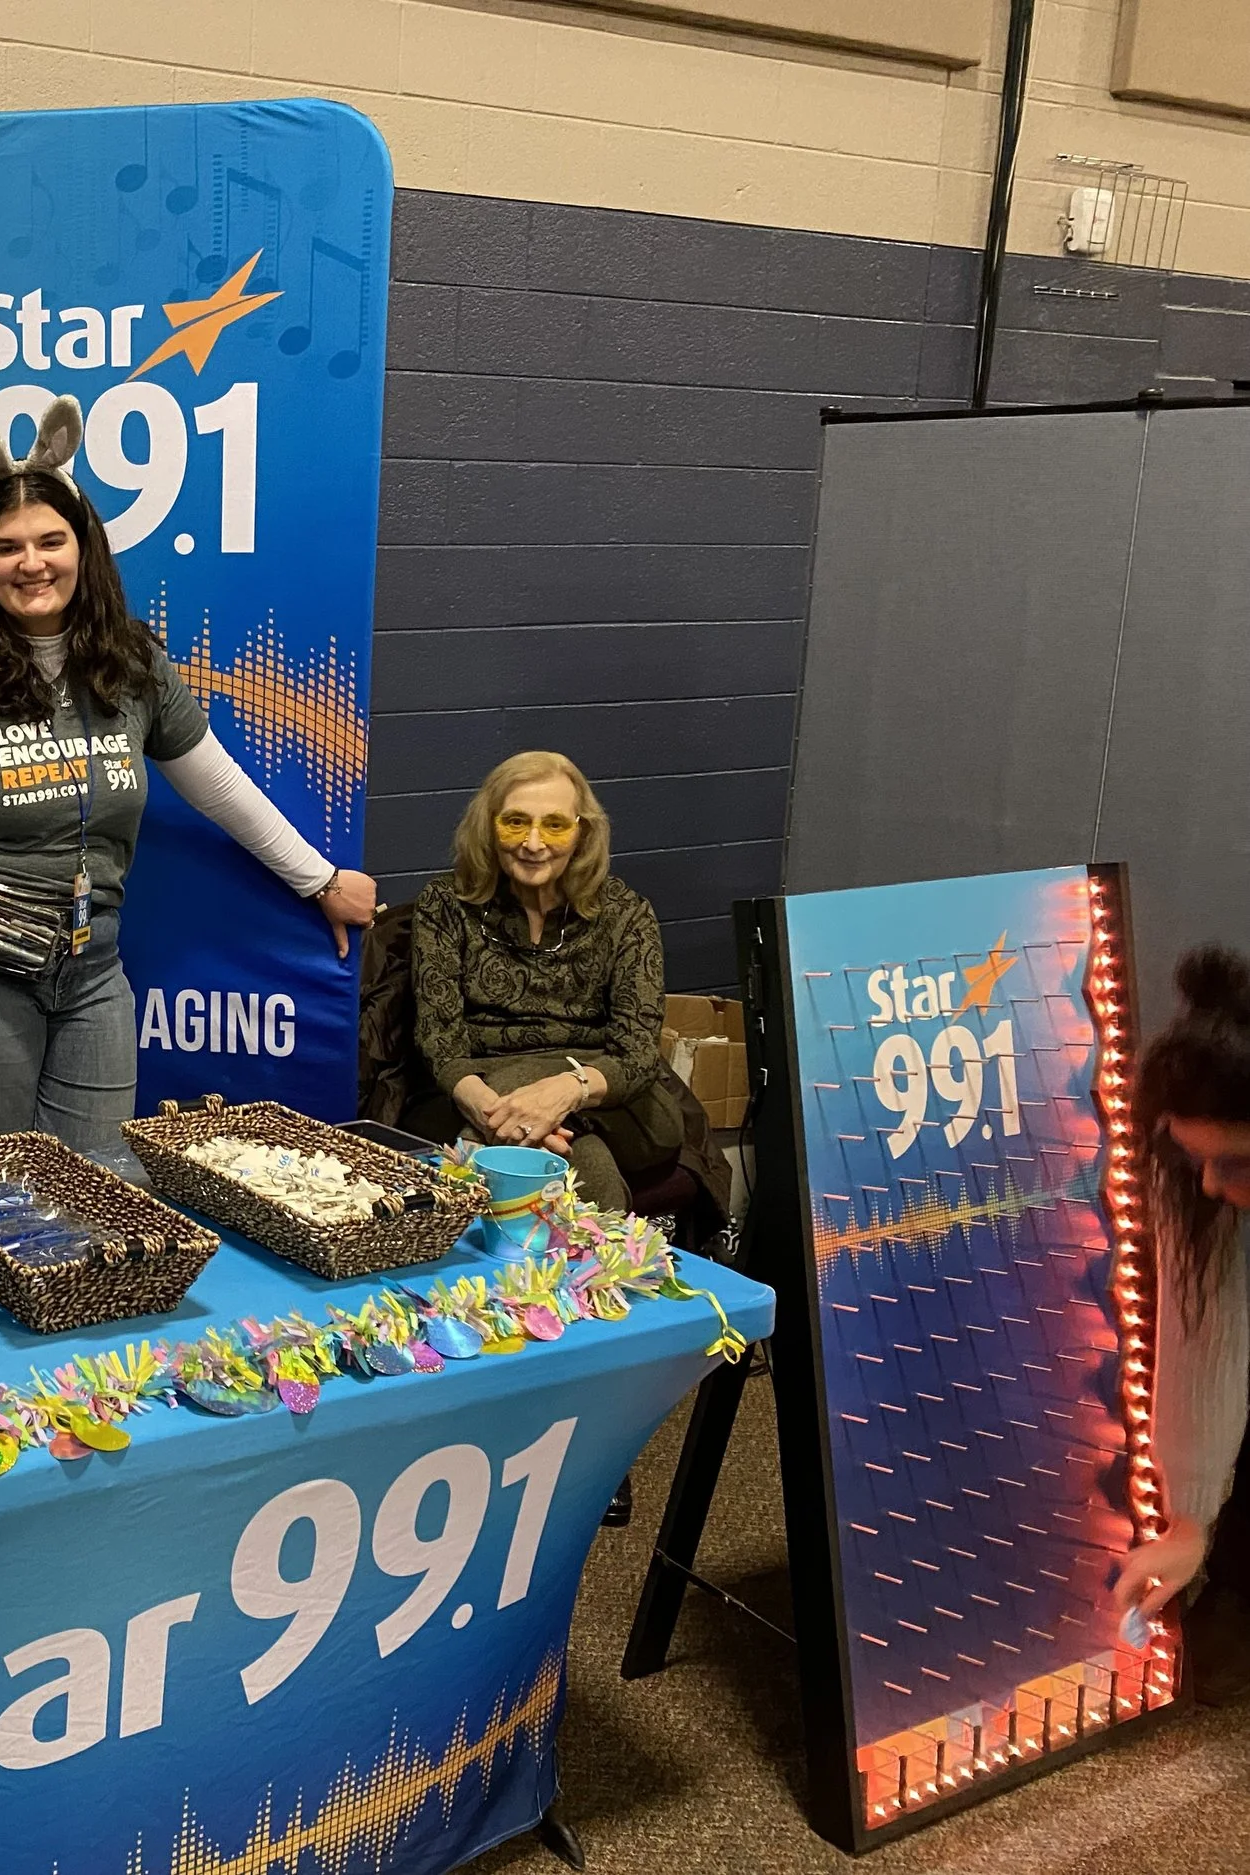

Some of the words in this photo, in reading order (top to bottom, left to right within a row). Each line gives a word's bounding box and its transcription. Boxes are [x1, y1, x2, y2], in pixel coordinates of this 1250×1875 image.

[1, 759, 88, 790] REPEAT
[103, 759, 123, 771] Star
[106, 768, 138, 791] 99.1
[2, 782, 89, 807] STAR991.COM
[867, 966, 956, 1028] Star
[873, 1019, 1022, 1160] 99.1
[230, 1416, 579, 1705] 99.1
